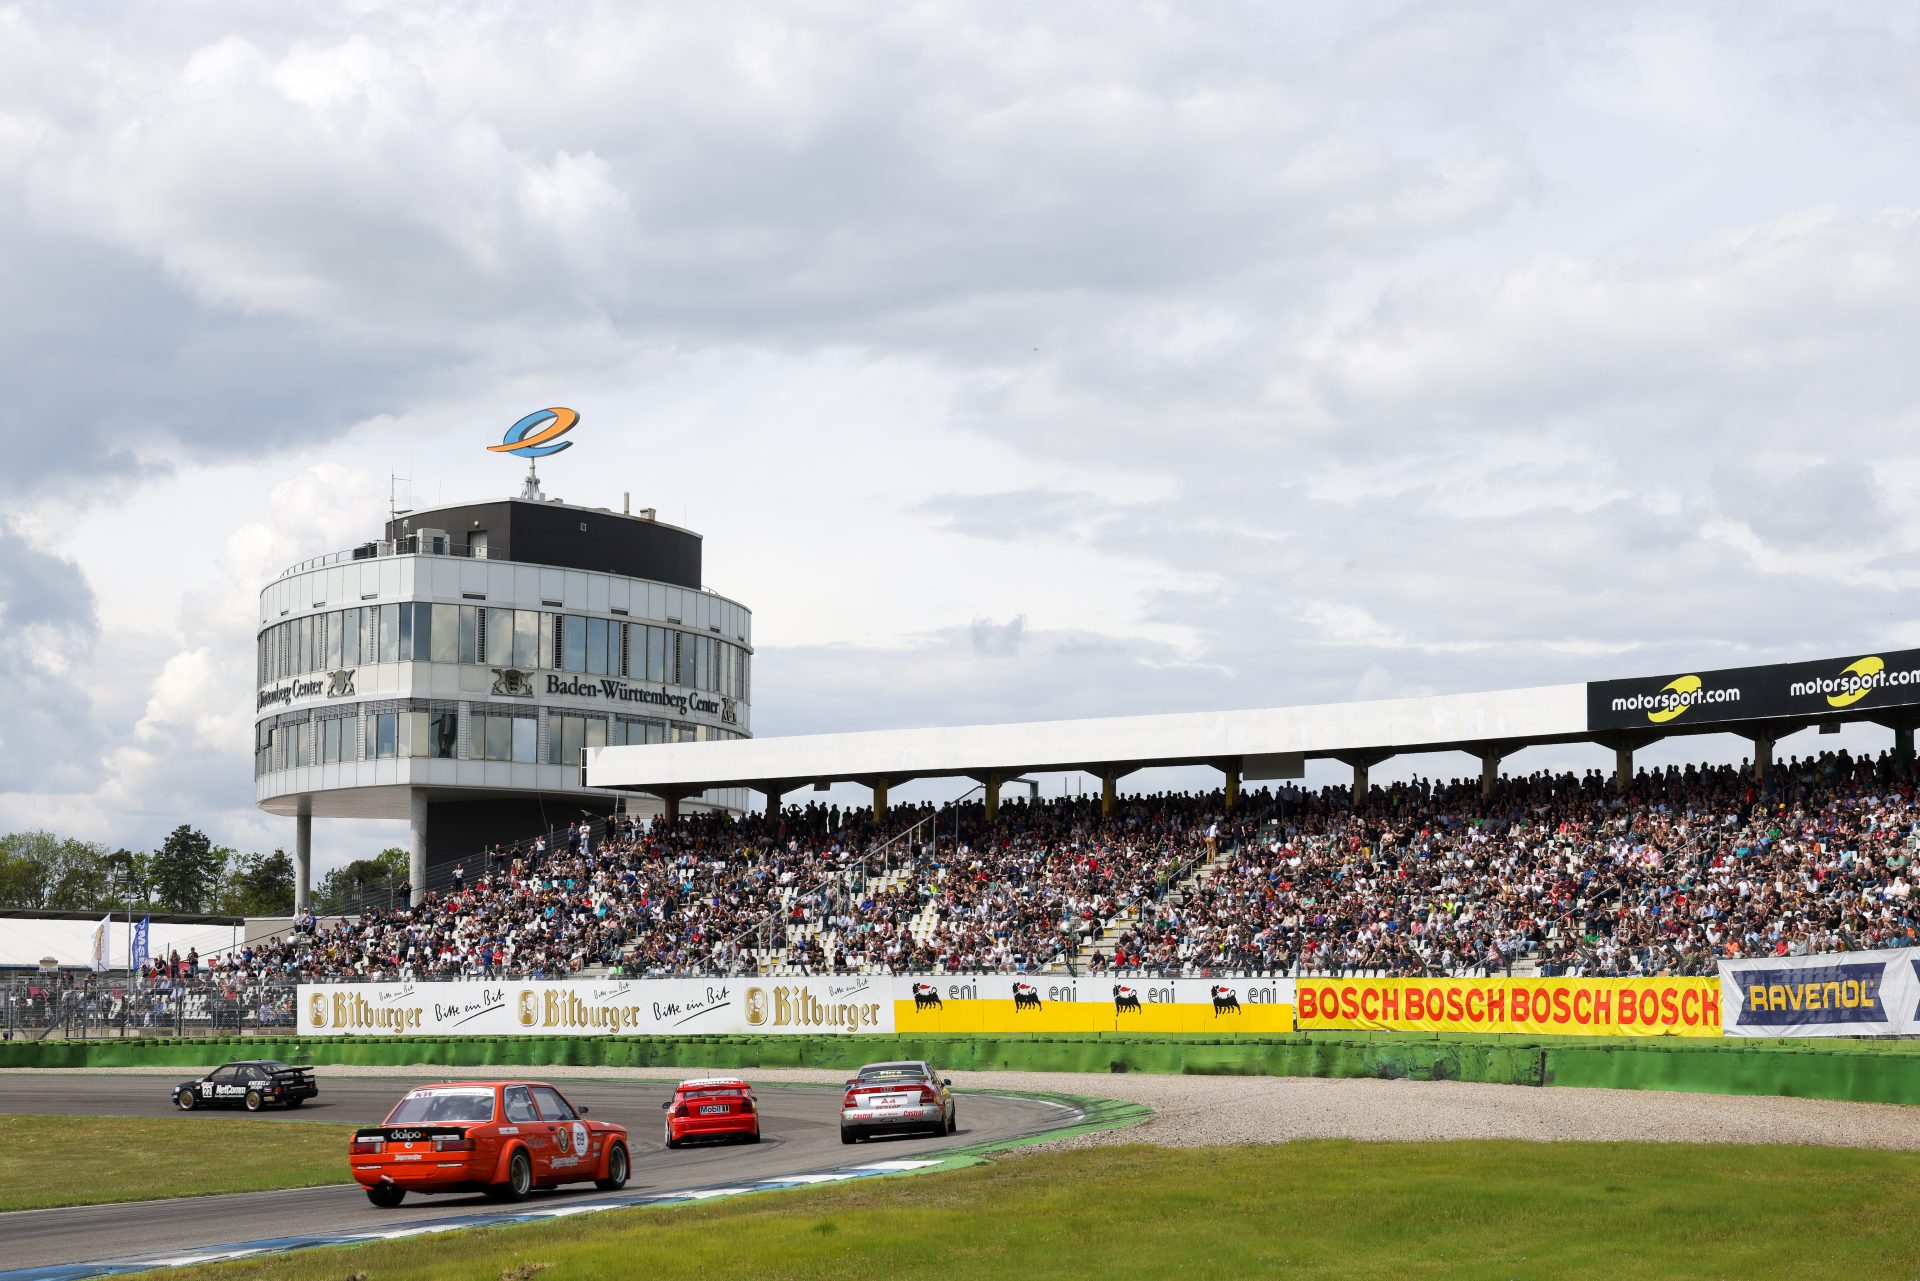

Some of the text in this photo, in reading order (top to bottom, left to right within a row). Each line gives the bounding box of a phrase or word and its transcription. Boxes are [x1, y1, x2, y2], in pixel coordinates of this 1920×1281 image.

[292, 679, 323, 698] Center
[546, 674, 719, 715] Baden-Württemberg Center
[1611, 687, 1740, 711] motorsport.com
[949, 977, 977, 999] eni
[1049, 980, 1077, 1002] eni
[1148, 981, 1175, 1003] eni
[1248, 980, 1276, 1004] eni
[1750, 979, 1875, 1011] RAVENOL
[332, 991, 423, 1033] Bitburger
[435, 988, 505, 1022] Bitte ein Bit
[542, 988, 640, 1034] Bitburger
[653, 986, 730, 1021] Bitte ein Bit
[773, 985, 880, 1032] Bitburger
[1299, 986, 1720, 1026] BOSCH BOSCH BOSCH BOSCH
[203, 1087, 212, 1096] 22
[216, 1085, 246, 1095] NetComm
[700, 1105, 721, 1113] Mobil
[852, 1112, 873, 1120] Castrol
[903, 1109, 924, 1117] Castrol
[391, 1129, 421, 1141] dalpo
[576, 1132, 584, 1146] 69
